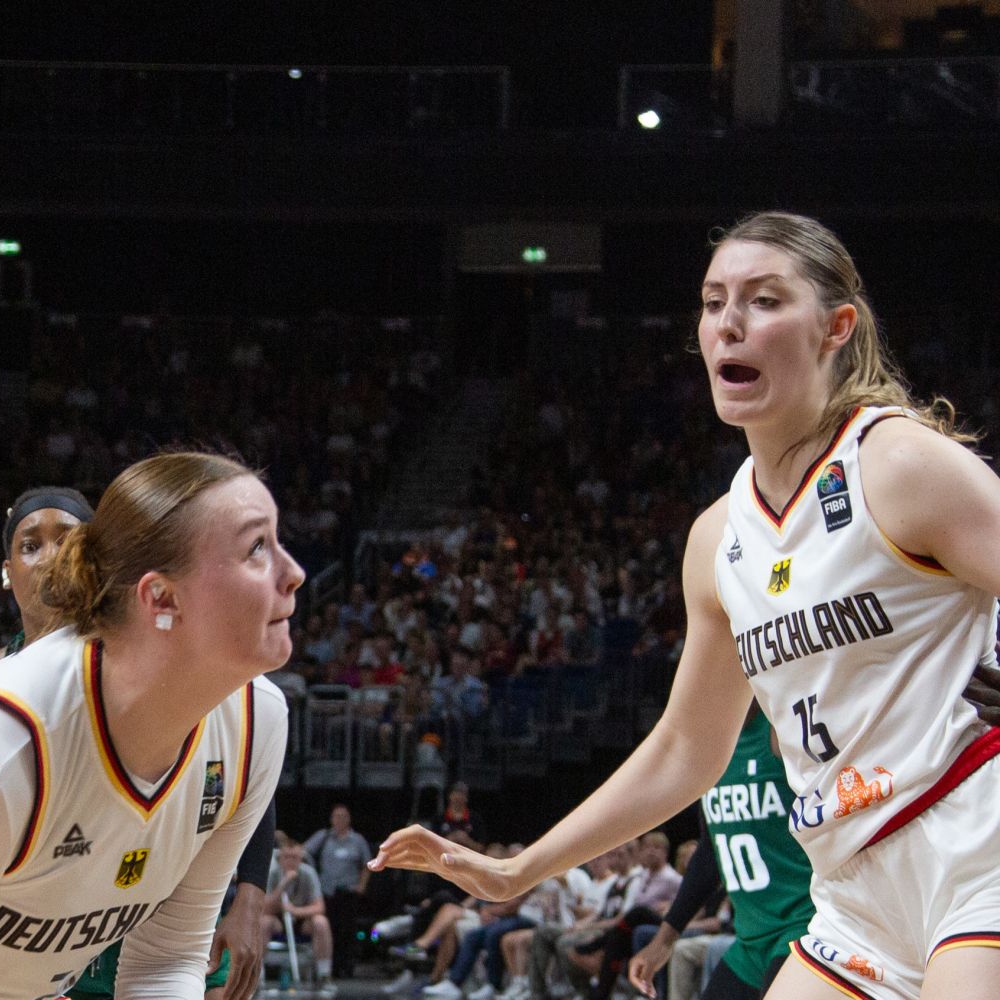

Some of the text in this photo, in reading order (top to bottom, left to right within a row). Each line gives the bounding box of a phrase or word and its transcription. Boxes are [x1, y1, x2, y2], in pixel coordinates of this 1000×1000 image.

[824, 498, 847, 516] FIBA
[735, 591, 894, 680] EUTSCHLAND
[792, 694, 840, 763] 15
[701, 781, 787, 824] IGERIA
[53, 841, 93, 860] PEAK
[715, 833, 770, 892] 10
